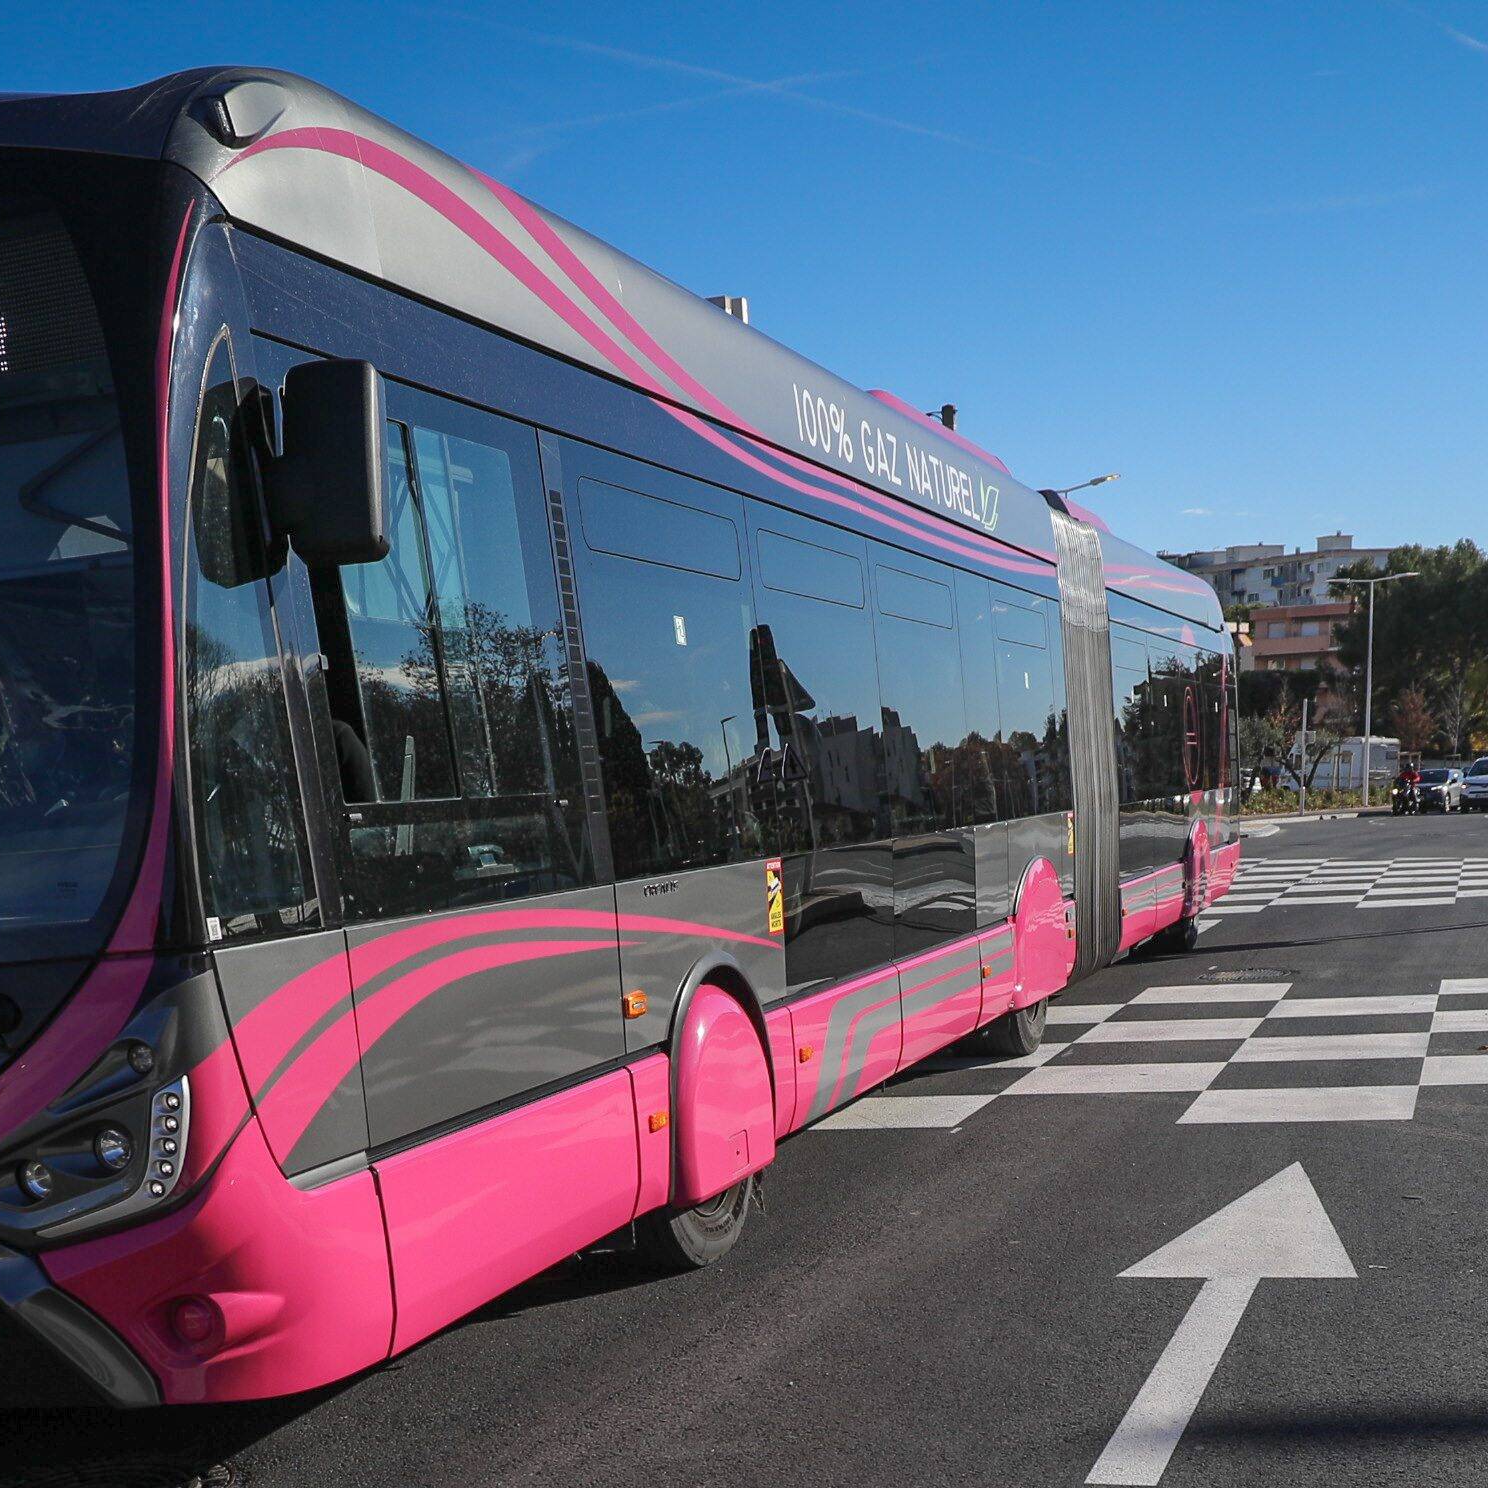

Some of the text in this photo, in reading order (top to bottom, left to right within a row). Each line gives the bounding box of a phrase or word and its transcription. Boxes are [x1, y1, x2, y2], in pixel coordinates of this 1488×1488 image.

[792, 382, 981, 522] 100% GAZ NATUREL
